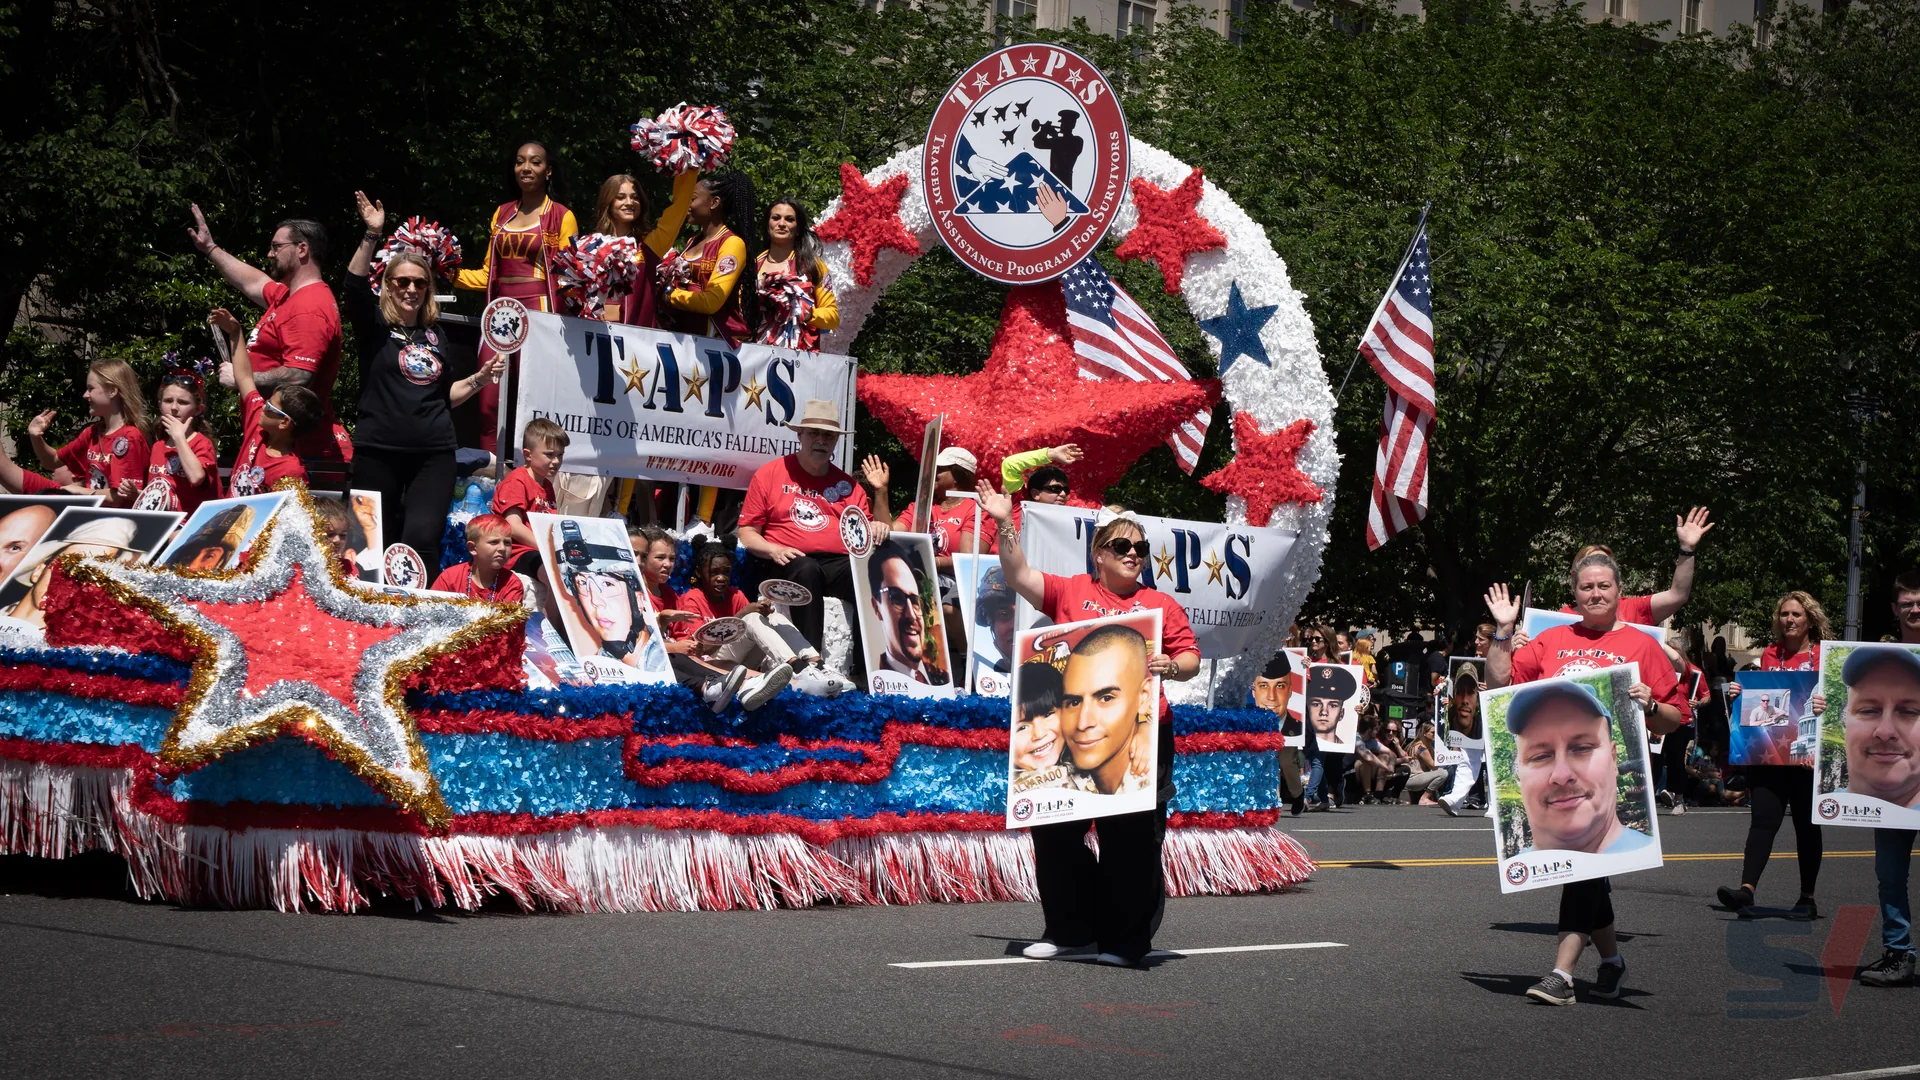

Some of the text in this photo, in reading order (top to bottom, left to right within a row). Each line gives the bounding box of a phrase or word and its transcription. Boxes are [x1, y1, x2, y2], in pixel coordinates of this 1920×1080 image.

[938, 209, 1003, 273] ASSISTANCE
[1007, 249, 1072, 275] PROGRAM
[1070, 224, 1098, 251] FOR
[1092, 131, 1120, 223] SURVIVORS
[532, 410, 613, 437] FMILIES
[616, 420, 638, 439] OF
[639, 424, 722, 450] AMERICA'S
[725, 433, 778, 456] FALLEN
[645, 455, 737, 478] WWW.TAPS.ORG
[1192, 607, 1235, 627] FALLEN
[1395, 661, 1404, 676] P
[1013, 768, 1063, 795] ALVARADO
